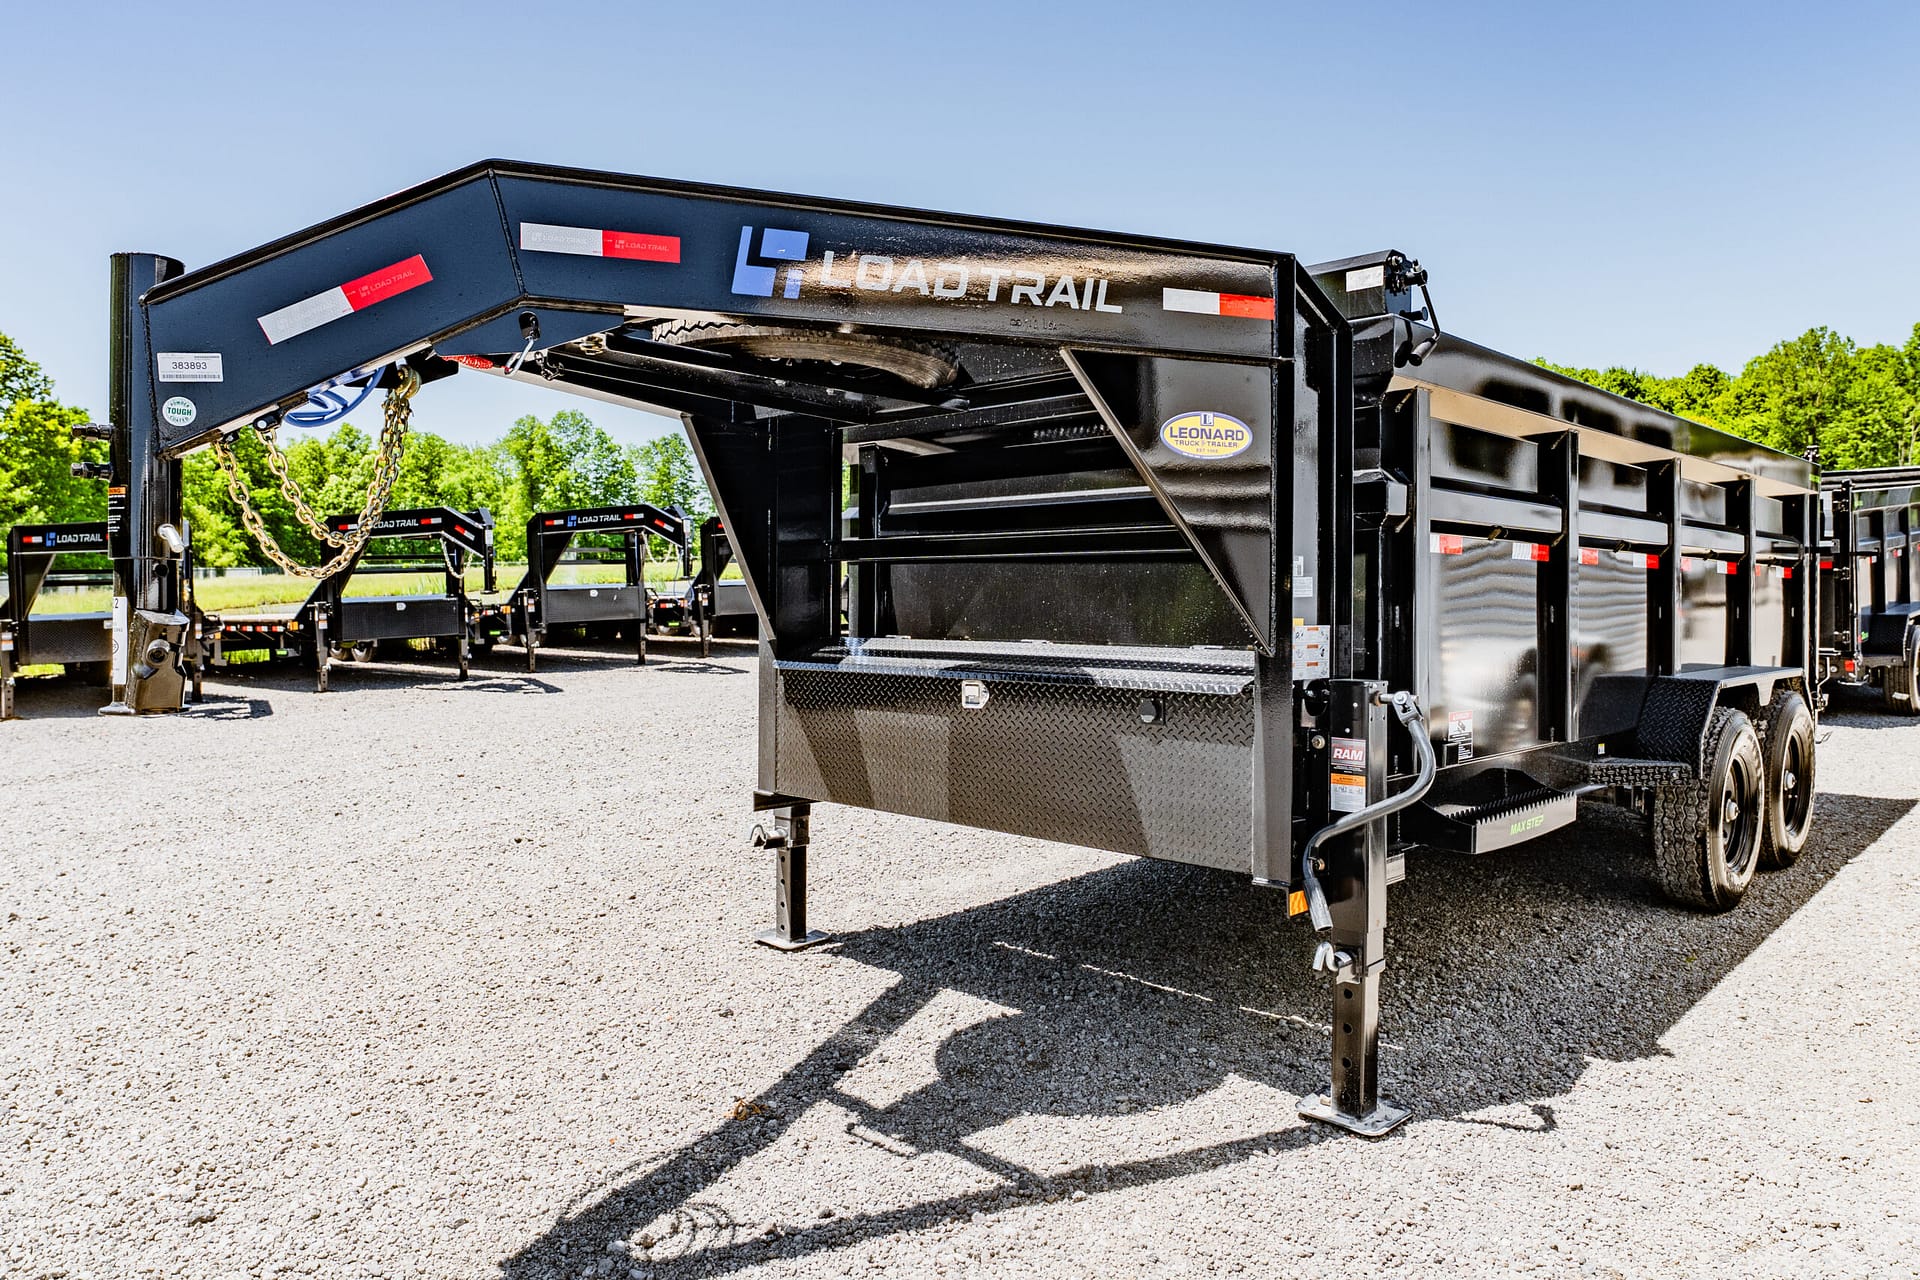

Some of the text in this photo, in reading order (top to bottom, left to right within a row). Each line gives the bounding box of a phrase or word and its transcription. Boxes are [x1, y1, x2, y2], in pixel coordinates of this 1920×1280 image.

[625, 242, 670, 252] LOAD TRAIL
[369, 269, 415, 293] LOAD TRAIL
[819, 250, 1123, 314] LOAD TRAIL
[171, 361, 208, 370] 383893
[166, 406, 192, 416] TOUGH
[1169, 426, 1245, 441] LEONARD
[1174, 439, 1200, 447] TRUCK
[395, 518, 419, 528] TRAIL
[577, 513, 622, 525] LOAD TRAIL
[56, 533, 103, 544] LOAD TRAIL
[1333, 748, 1363, 761] RAM
[1510, 815, 1544, 836] MAX STEP
